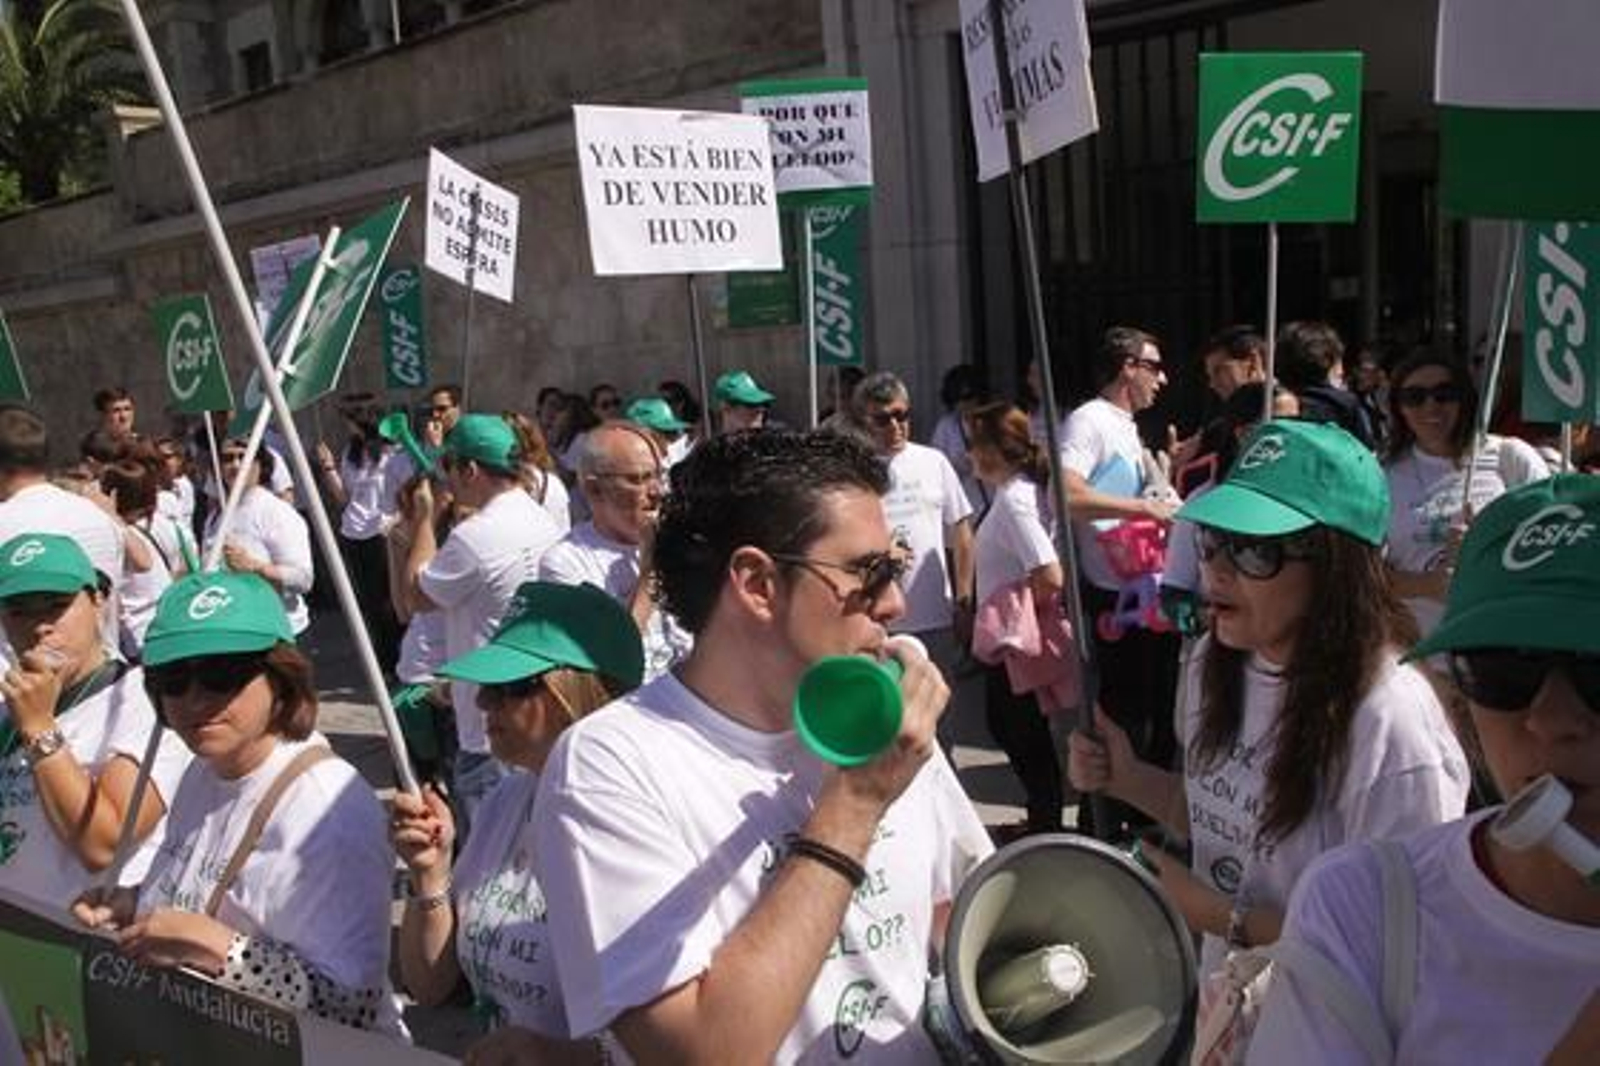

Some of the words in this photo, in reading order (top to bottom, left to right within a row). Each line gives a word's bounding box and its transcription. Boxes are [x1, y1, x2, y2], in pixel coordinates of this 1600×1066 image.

[589, 143, 626, 169] YA
[632, 139, 700, 170] ESTÁ
[706, 147, 763, 172] BIEN
[438, 174, 456, 201] LA
[602, 181, 644, 207] DE
[651, 181, 767, 207] VENDER
[433, 200, 454, 227] NO
[646, 218, 738, 246] HUMO
